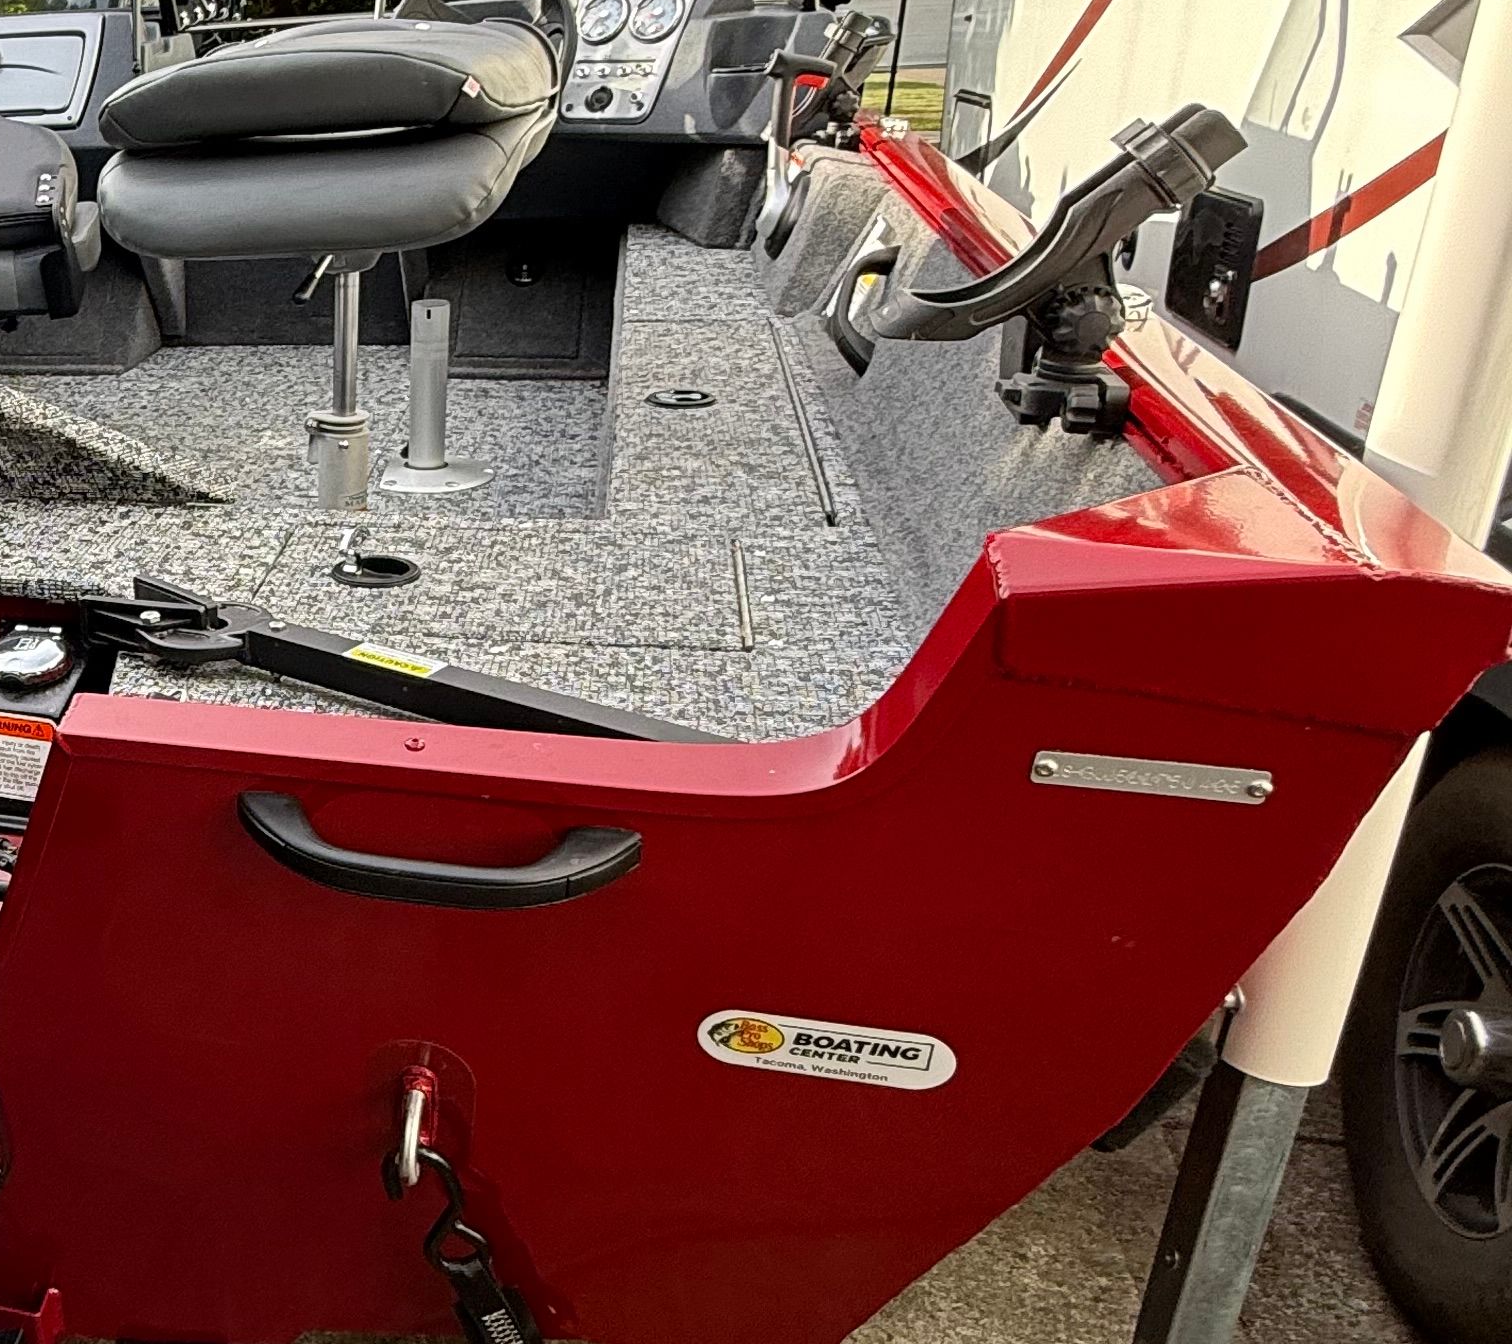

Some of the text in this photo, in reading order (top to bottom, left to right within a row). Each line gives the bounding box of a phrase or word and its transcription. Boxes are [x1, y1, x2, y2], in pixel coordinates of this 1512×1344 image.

[740, 1020, 769, 1033] Bass
[738, 1029, 762, 1041] Pro
[737, 1038, 774, 1051] Shops
[792, 1032, 922, 1061] BOATING
[789, 1047, 861, 1065] CENTER
[754, 1057, 889, 1082] Tacoma, Washington
